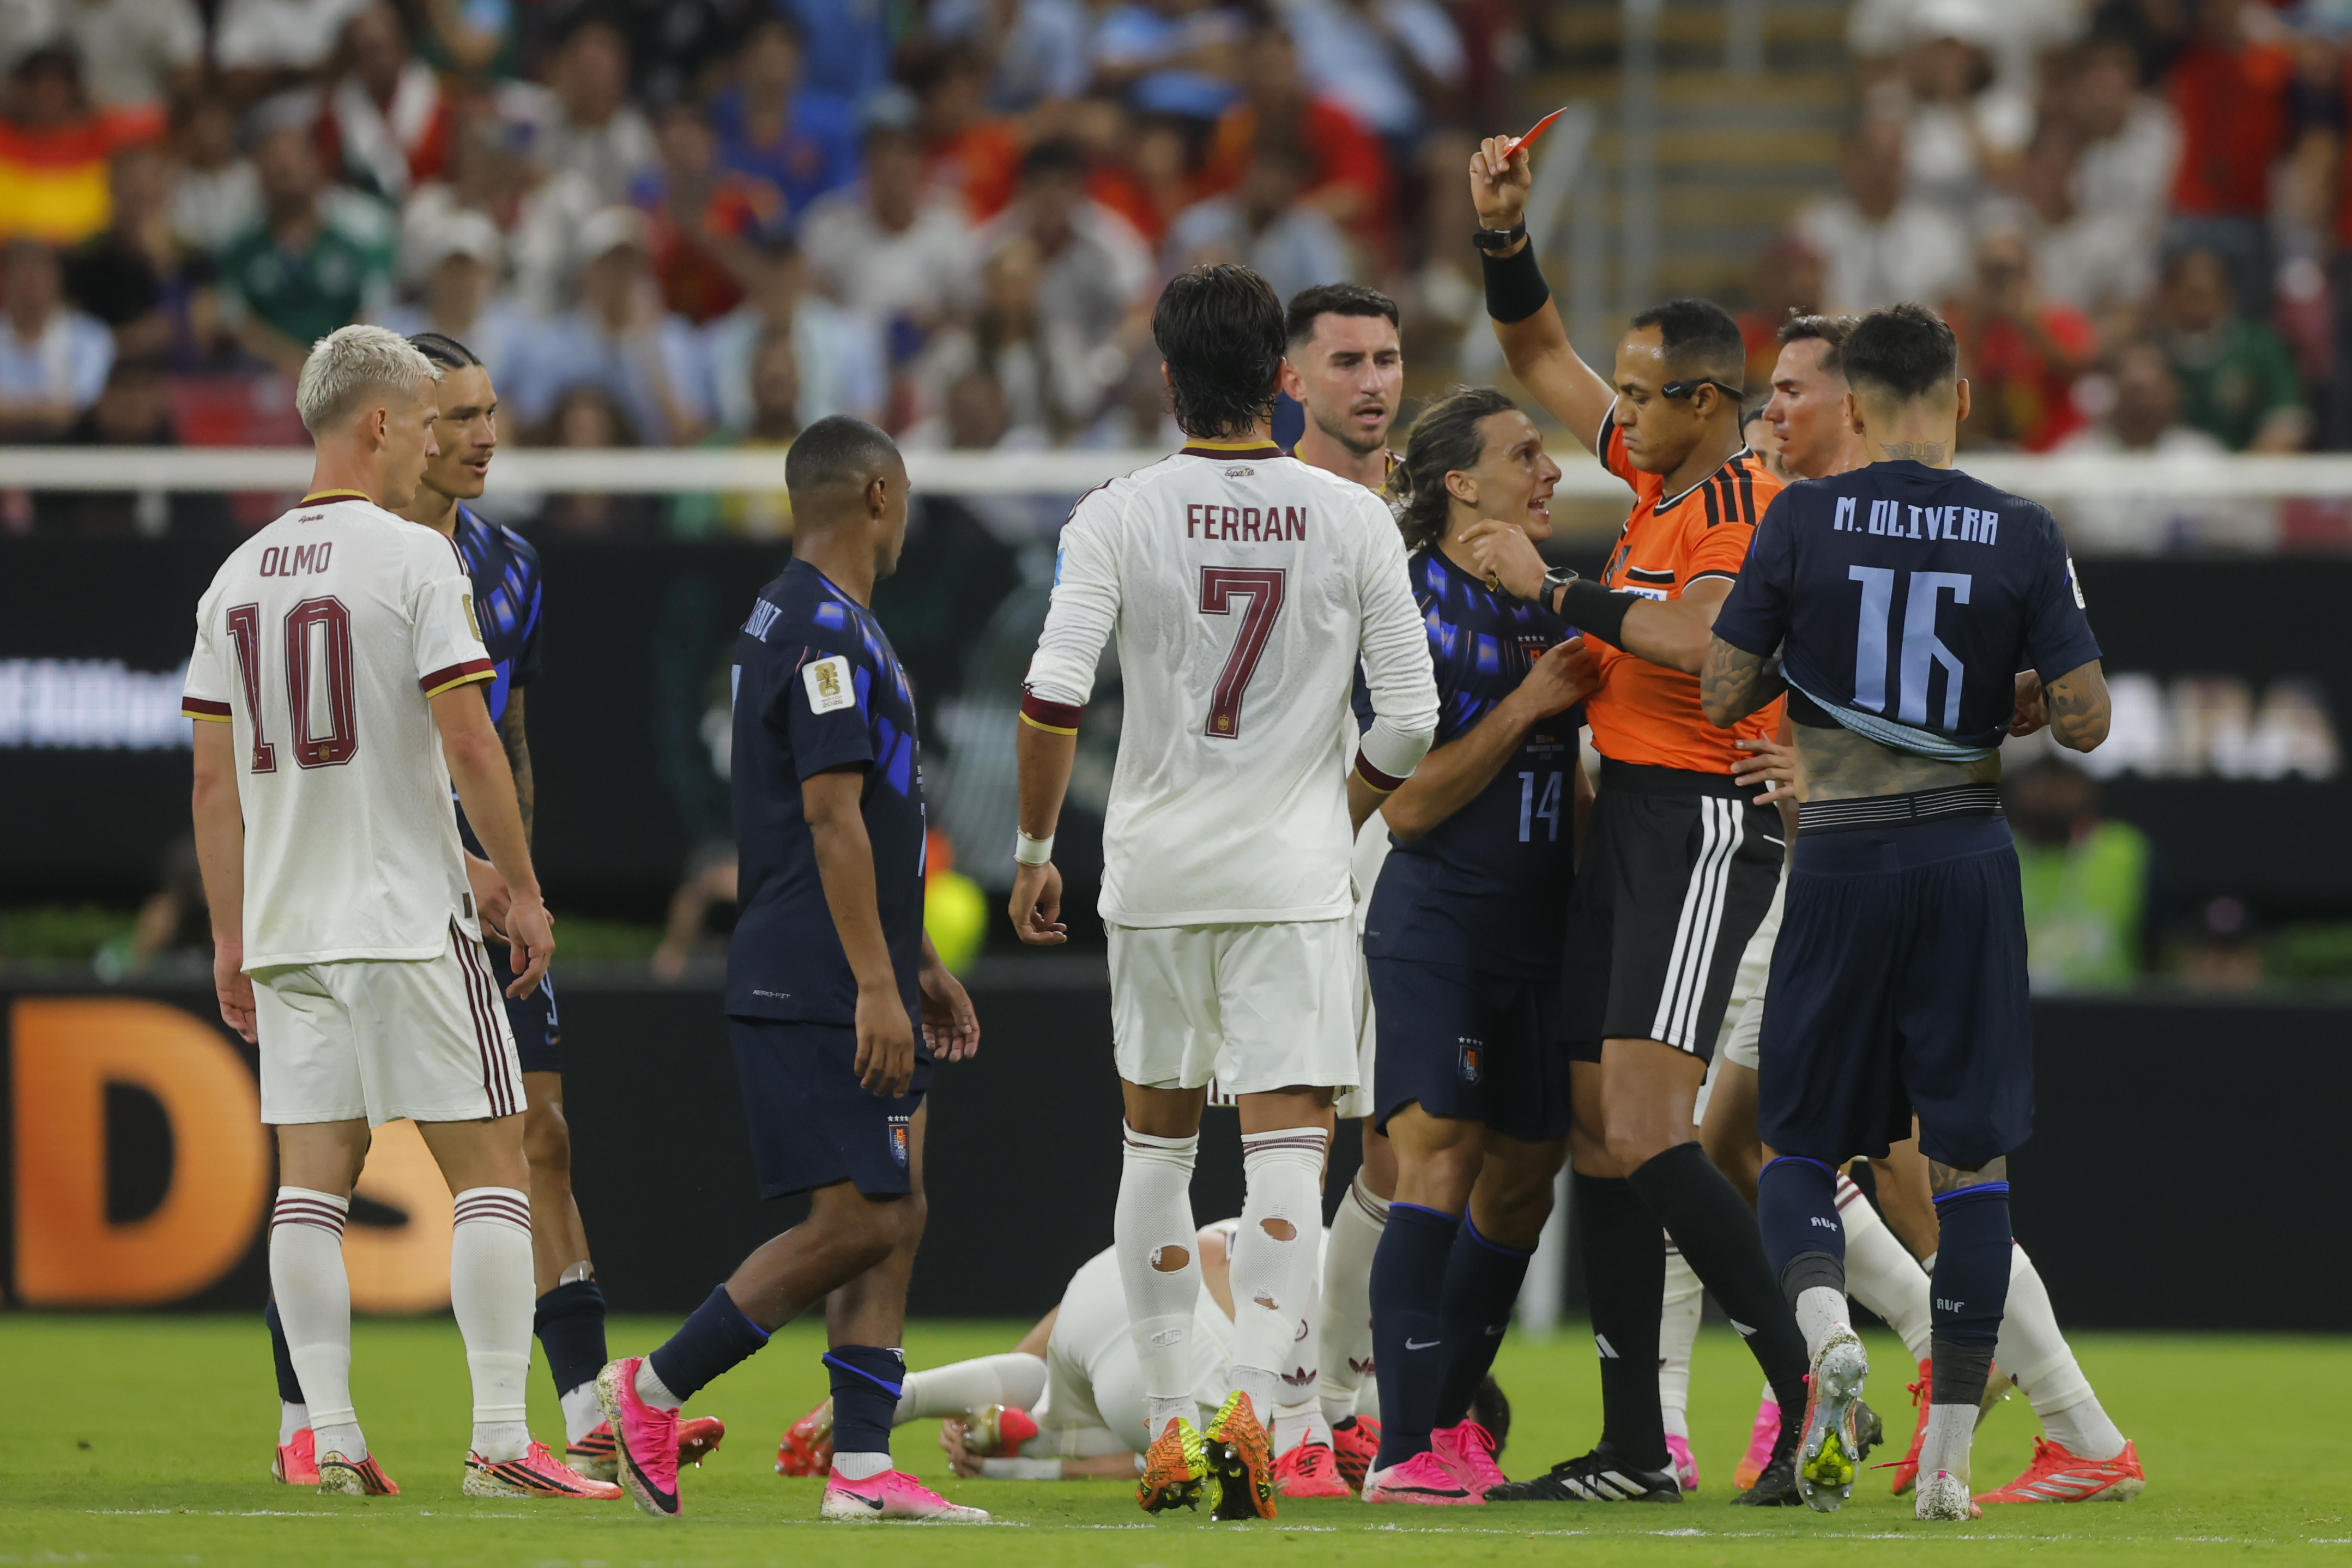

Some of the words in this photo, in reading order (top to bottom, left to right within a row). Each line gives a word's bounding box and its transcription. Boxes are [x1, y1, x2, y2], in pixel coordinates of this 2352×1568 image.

[1187, 504, 1307, 542] FERRAN
[1833, 497, 1863, 533] M.
[1868, 499, 1999, 546] OLIVERA
[259, 542, 332, 577] OLMO
[1199, 566, 1286, 739] 7
[1848, 565, 1972, 731] 16
[227, 595, 359, 774] 10
[823, 699, 843, 708] 2026
[1518, 771, 1562, 842] 14
[1810, 1216, 1837, 1232] AUF
[1936, 1298, 1964, 1313] AUF
